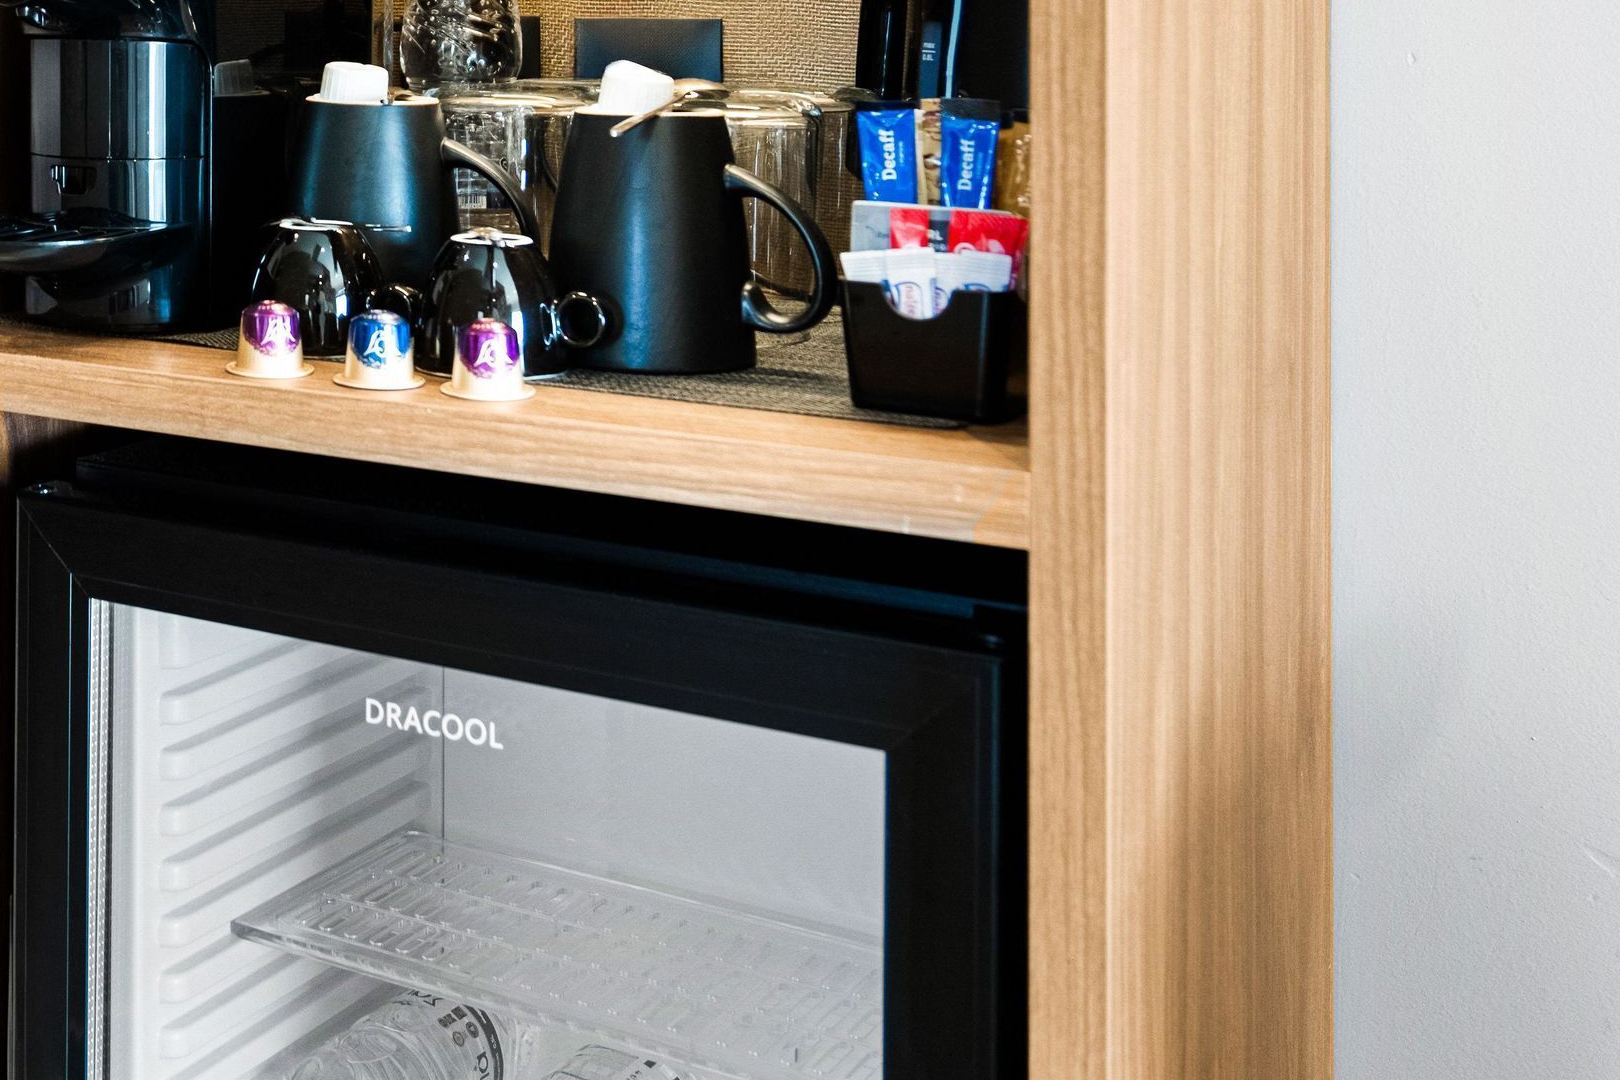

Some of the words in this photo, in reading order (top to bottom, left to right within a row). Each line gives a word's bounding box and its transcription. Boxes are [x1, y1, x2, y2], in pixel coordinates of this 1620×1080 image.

[878, 128, 898, 181] Decaff
[956, 137, 976, 192] Decaff
[365, 697, 504, 750] DRACOOL
